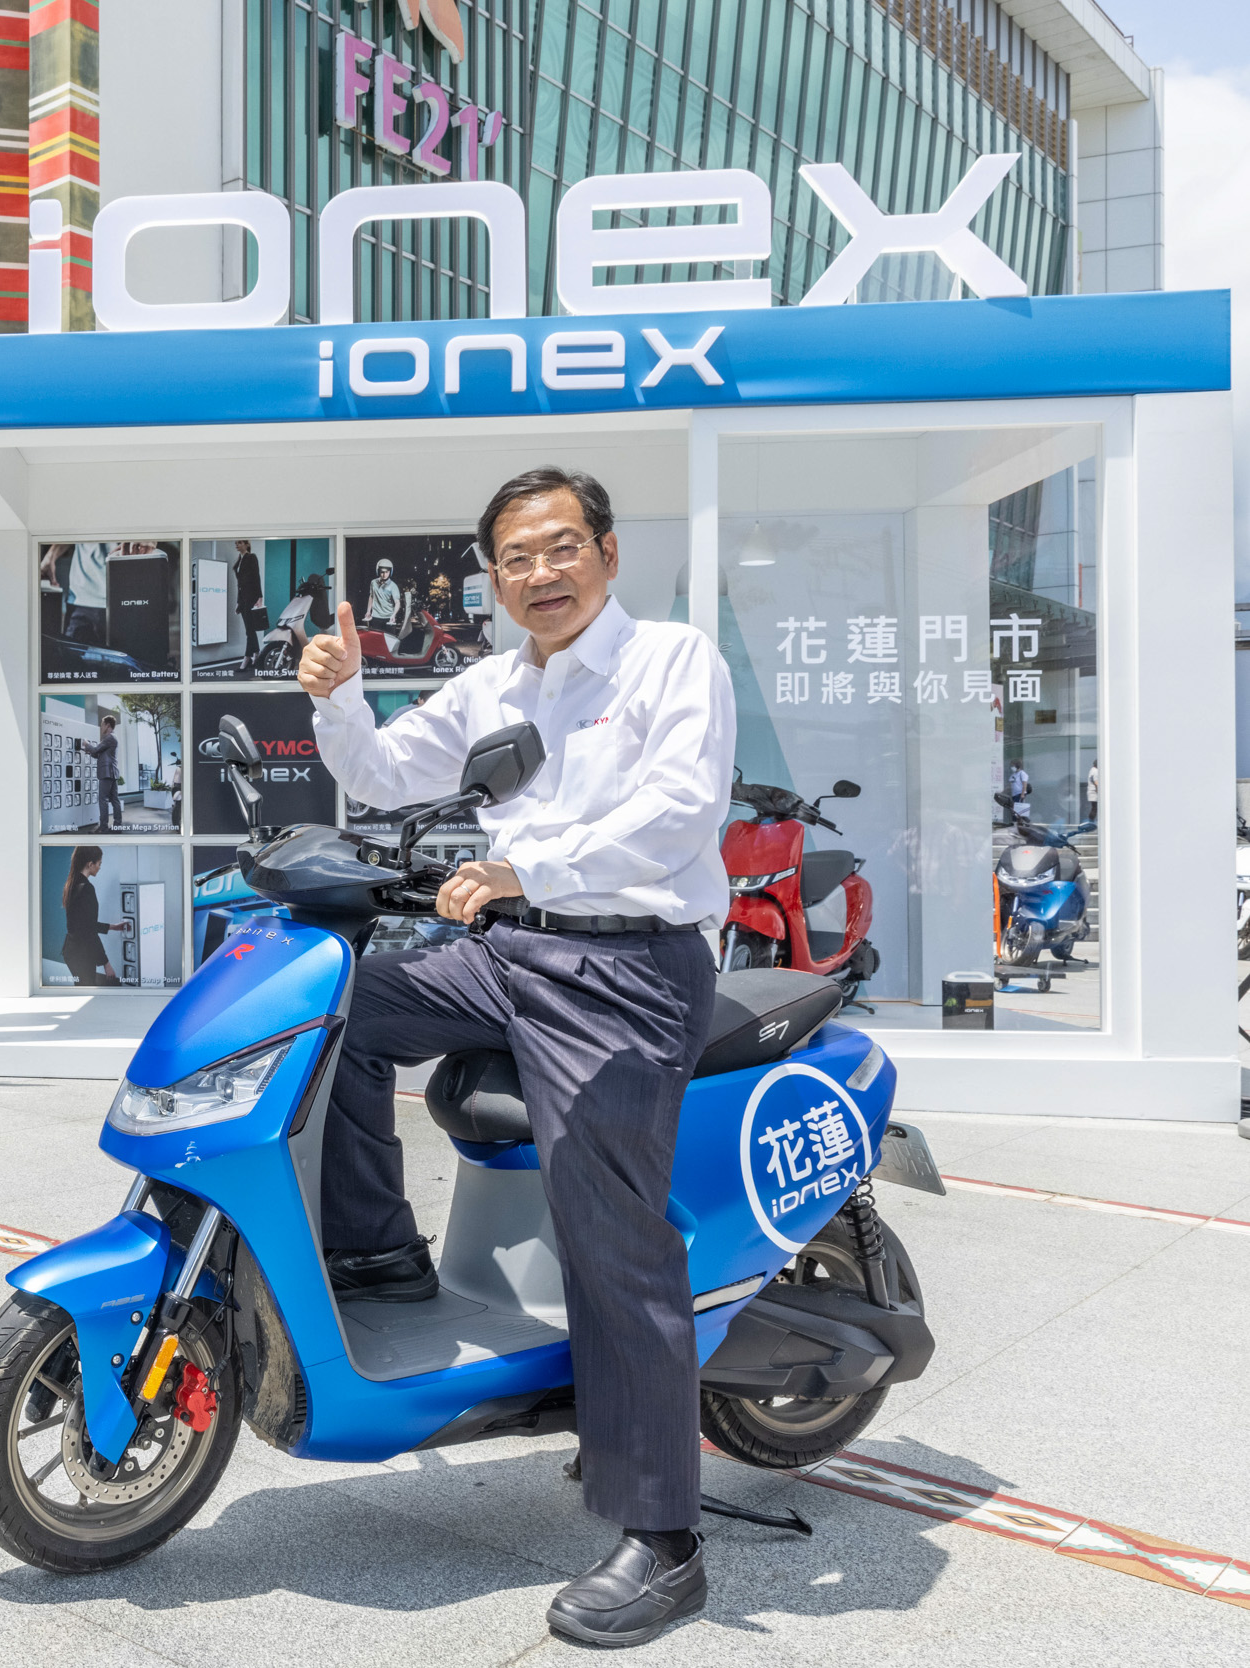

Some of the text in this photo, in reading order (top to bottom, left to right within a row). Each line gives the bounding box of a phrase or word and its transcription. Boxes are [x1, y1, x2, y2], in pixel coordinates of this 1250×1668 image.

[28, 152, 1028, 333] ionex
[319, 325, 725, 398] ionex
[776, 613, 1042, 664] 花蓮門市
[281, 668, 299, 676] Swa
[775, 669, 1043, 705] 即將與你見面
[253, 740, 320, 755] YMC
[132, 824, 151, 832] Mega
[435, 823, 458, 831] lug-In
[459, 823, 481, 831] Charg
[225, 943, 255, 960] R
[758, 1100, 855, 1188] 花蓮
[772, 1161, 862, 1218] ionex
